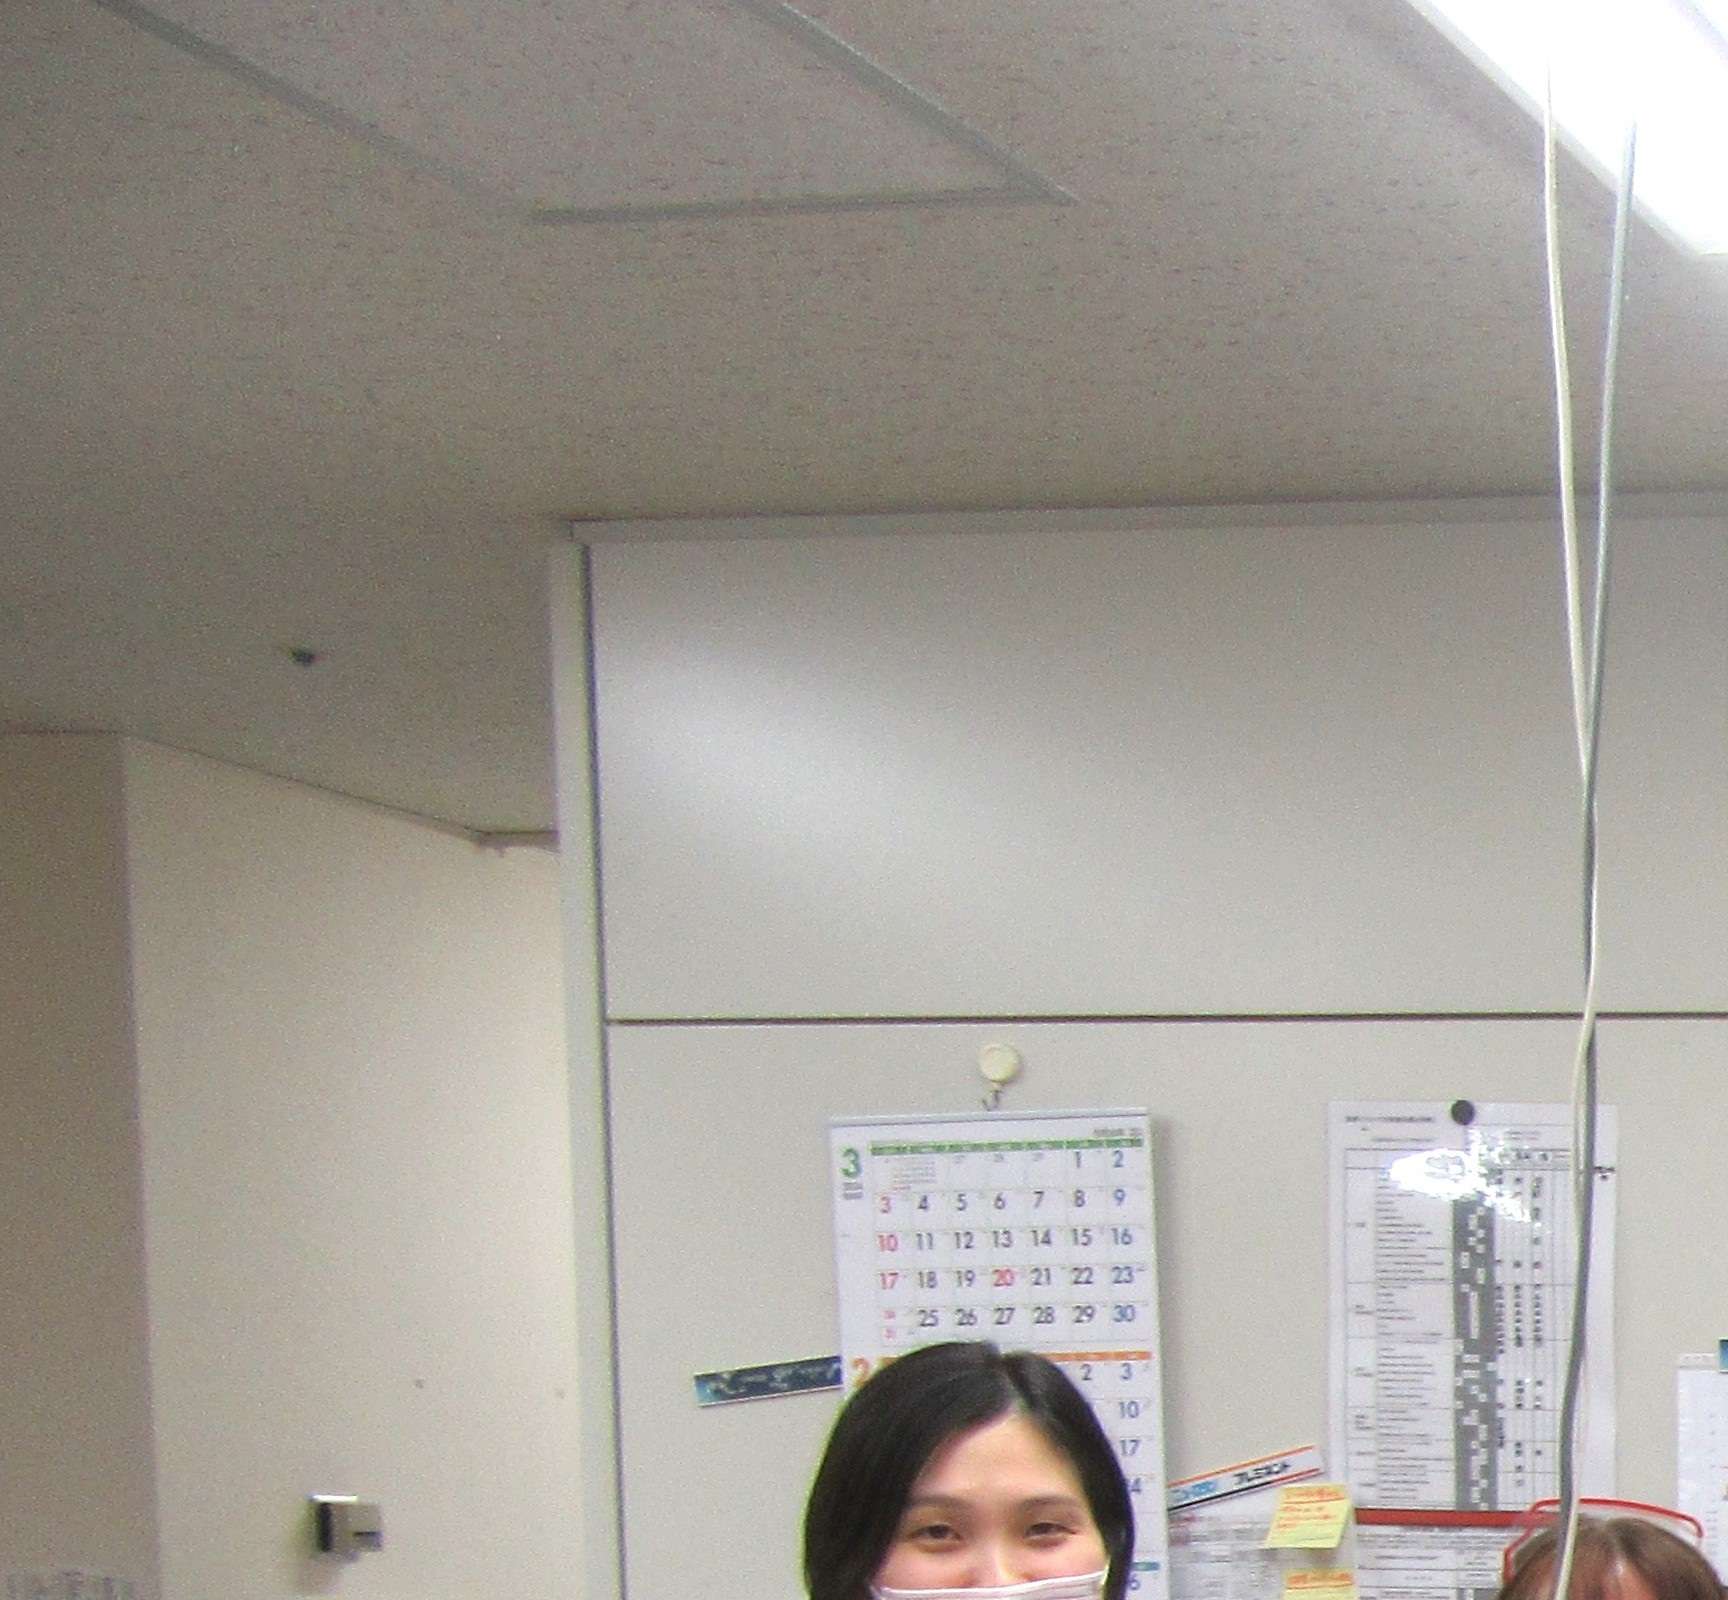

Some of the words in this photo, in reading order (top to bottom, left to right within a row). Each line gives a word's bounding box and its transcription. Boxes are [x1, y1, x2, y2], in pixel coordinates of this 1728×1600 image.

[840, 1146, 863, 1179] 3
[1073, 1149, 1083, 1169] 1
[1111, 1148, 1125, 1168] 2
[880, 1195, 892, 1214] 3
[917, 1194, 929, 1211] 4
[956, 1192, 968, 1212] 5
[994, 1194, 1006, 1210] 6
[1033, 1190, 1045, 1207] 7
[1073, 1188, 1086, 1208] 8
[1112, 1187, 1126, 1206] 9
[878, 1233, 899, 1253] 10
[915, 1232, 934, 1250] 11
[954, 1231, 973, 1250] 12
[992, 1229, 1013, 1249] 13
[1031, 1229, 1052, 1246] 14
[1071, 1227, 1093, 1247] 15
[1111, 1227, 1133, 1246] 16
[880, 1271, 899, 1289] 17
[917, 1270, 938, 1290] 18
[955, 1269, 976, 1287] 19
[991, 1268, 1015, 1288] 20
[1030, 1267, 1051, 1286] 21
[1072, 1266, 1093, 1285] 22
[1111, 1265, 1134, 1285] 23
[918, 1309, 939, 1328] 25
[955, 1307, 977, 1327] 26
[993, 1306, 1016, 1326] 27
[1032, 1305, 1055, 1325] 28
[1073, 1304, 1096, 1324] 29
[1113, 1304, 1136, 1323] 30
[1080, 1363, 1093, 1382] 2
[1119, 1362, 1133, 1381] 3
[1118, 1400, 1140, 1419] 10
[1119, 1439, 1141, 1457] 17
